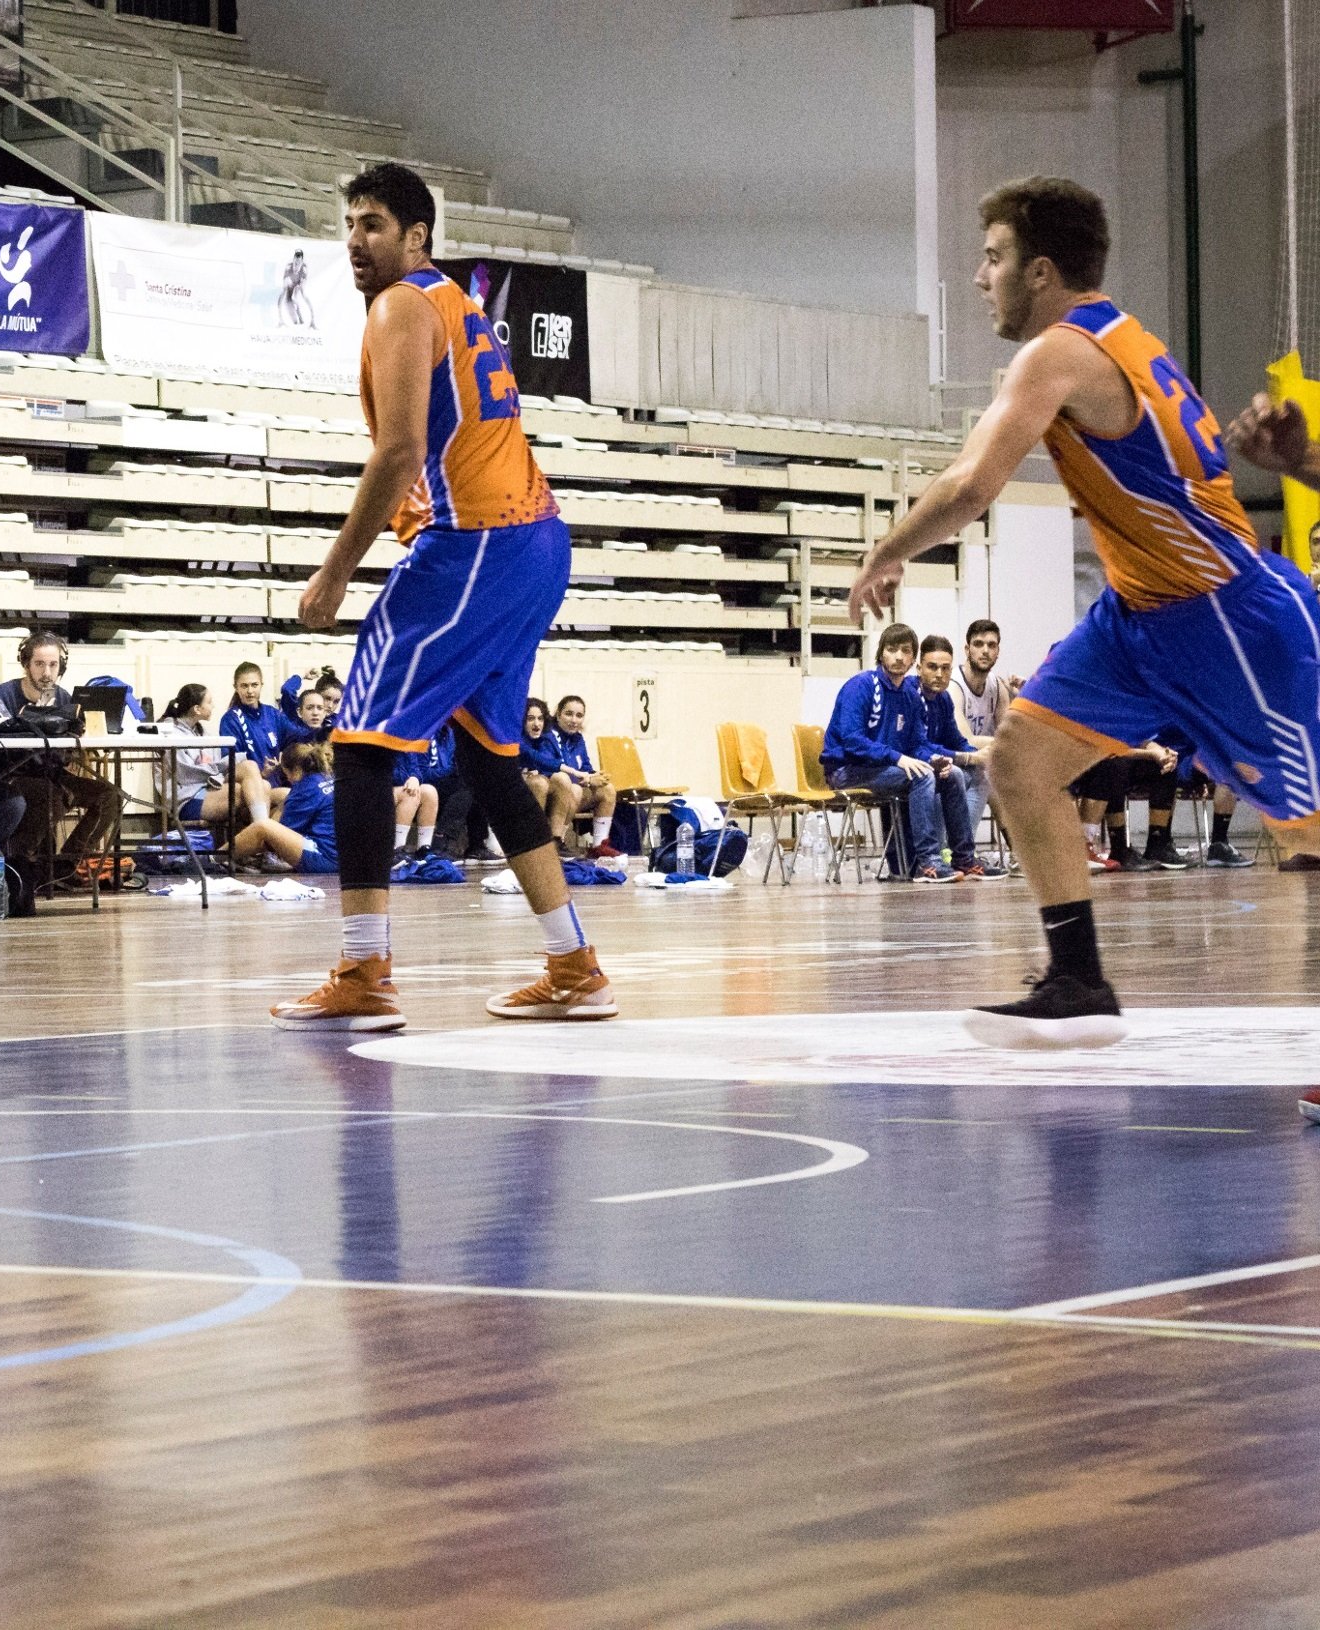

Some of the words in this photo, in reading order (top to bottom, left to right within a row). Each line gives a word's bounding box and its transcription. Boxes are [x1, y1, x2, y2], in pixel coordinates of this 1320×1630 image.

[165, 283, 192, 297] Cristina
[636, 679, 655, 688] pista
[639, 689, 650, 733] 3
